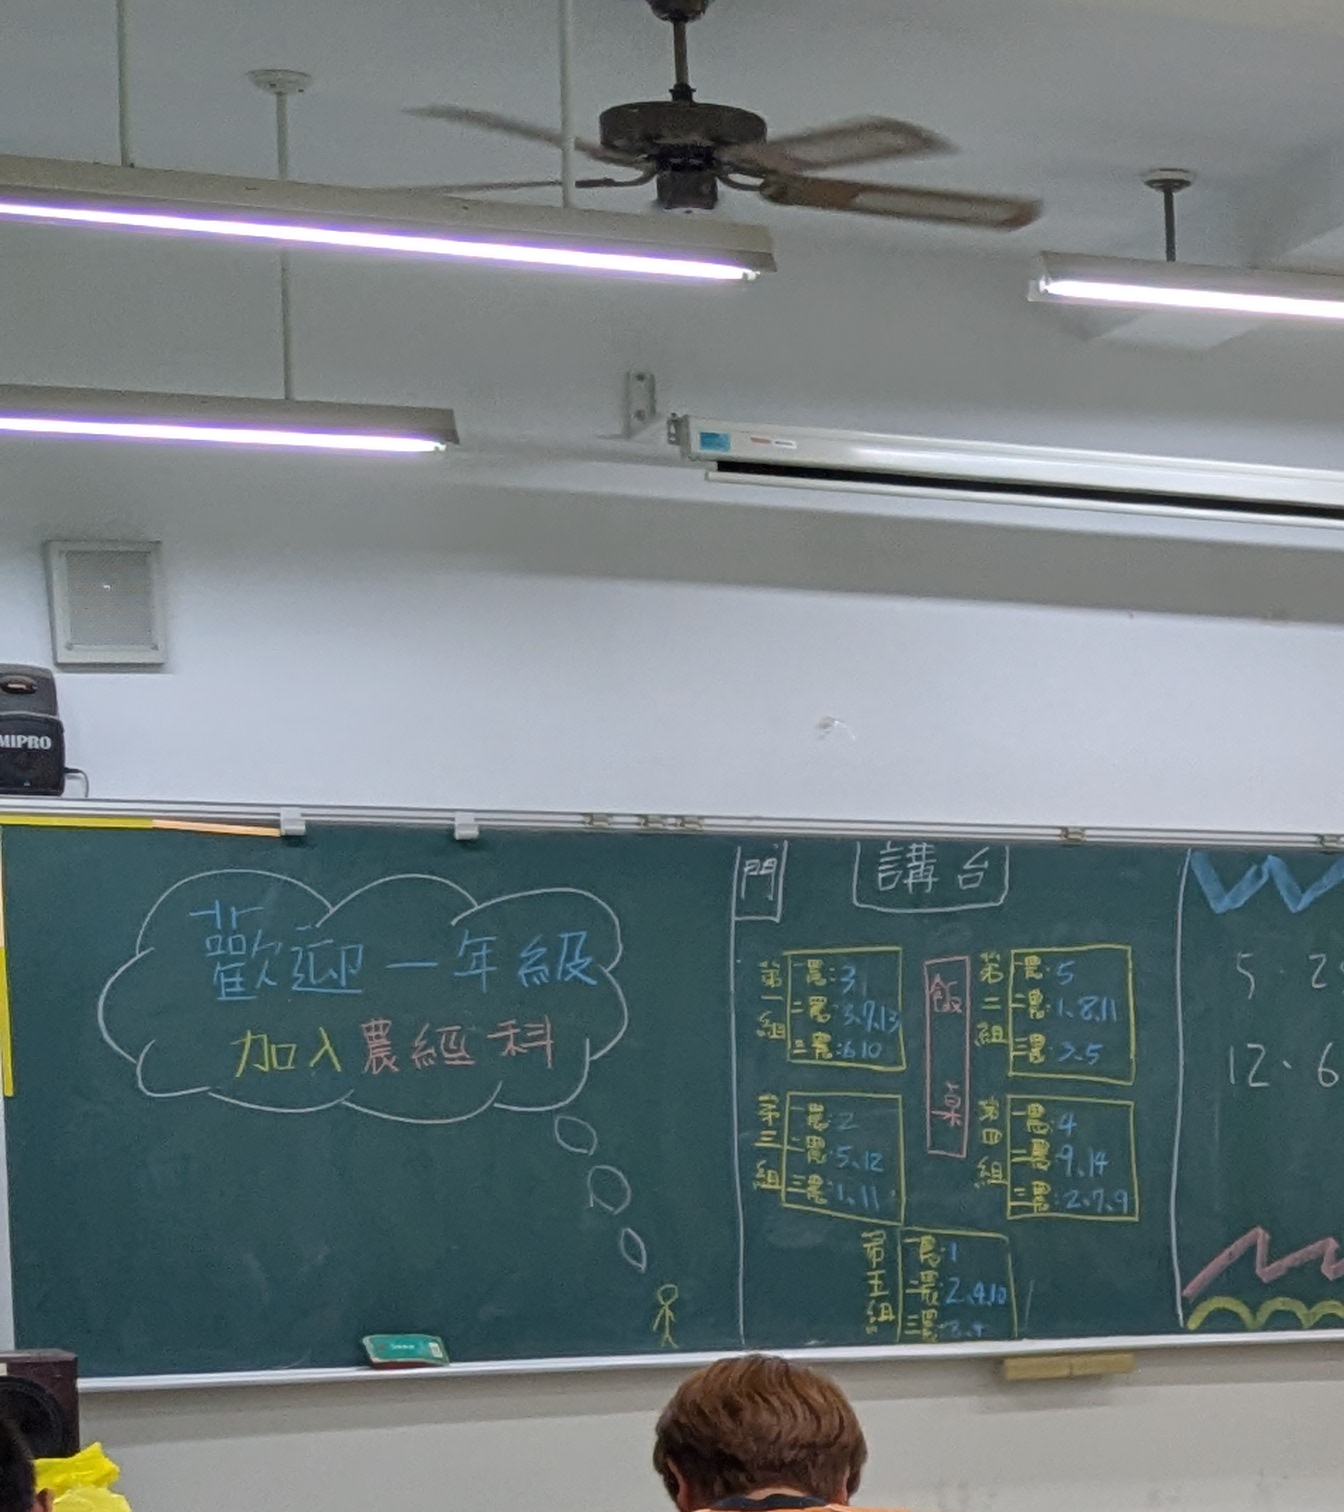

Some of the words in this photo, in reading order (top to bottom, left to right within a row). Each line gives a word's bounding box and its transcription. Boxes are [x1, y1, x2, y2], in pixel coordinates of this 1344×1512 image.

[0, 734, 52, 750] MIPRO
[877, 842, 991, 894] 講台
[189, 899, 598, 1001] 歡迎一年級
[231, 1016, 556, 1078] 加入農經科
